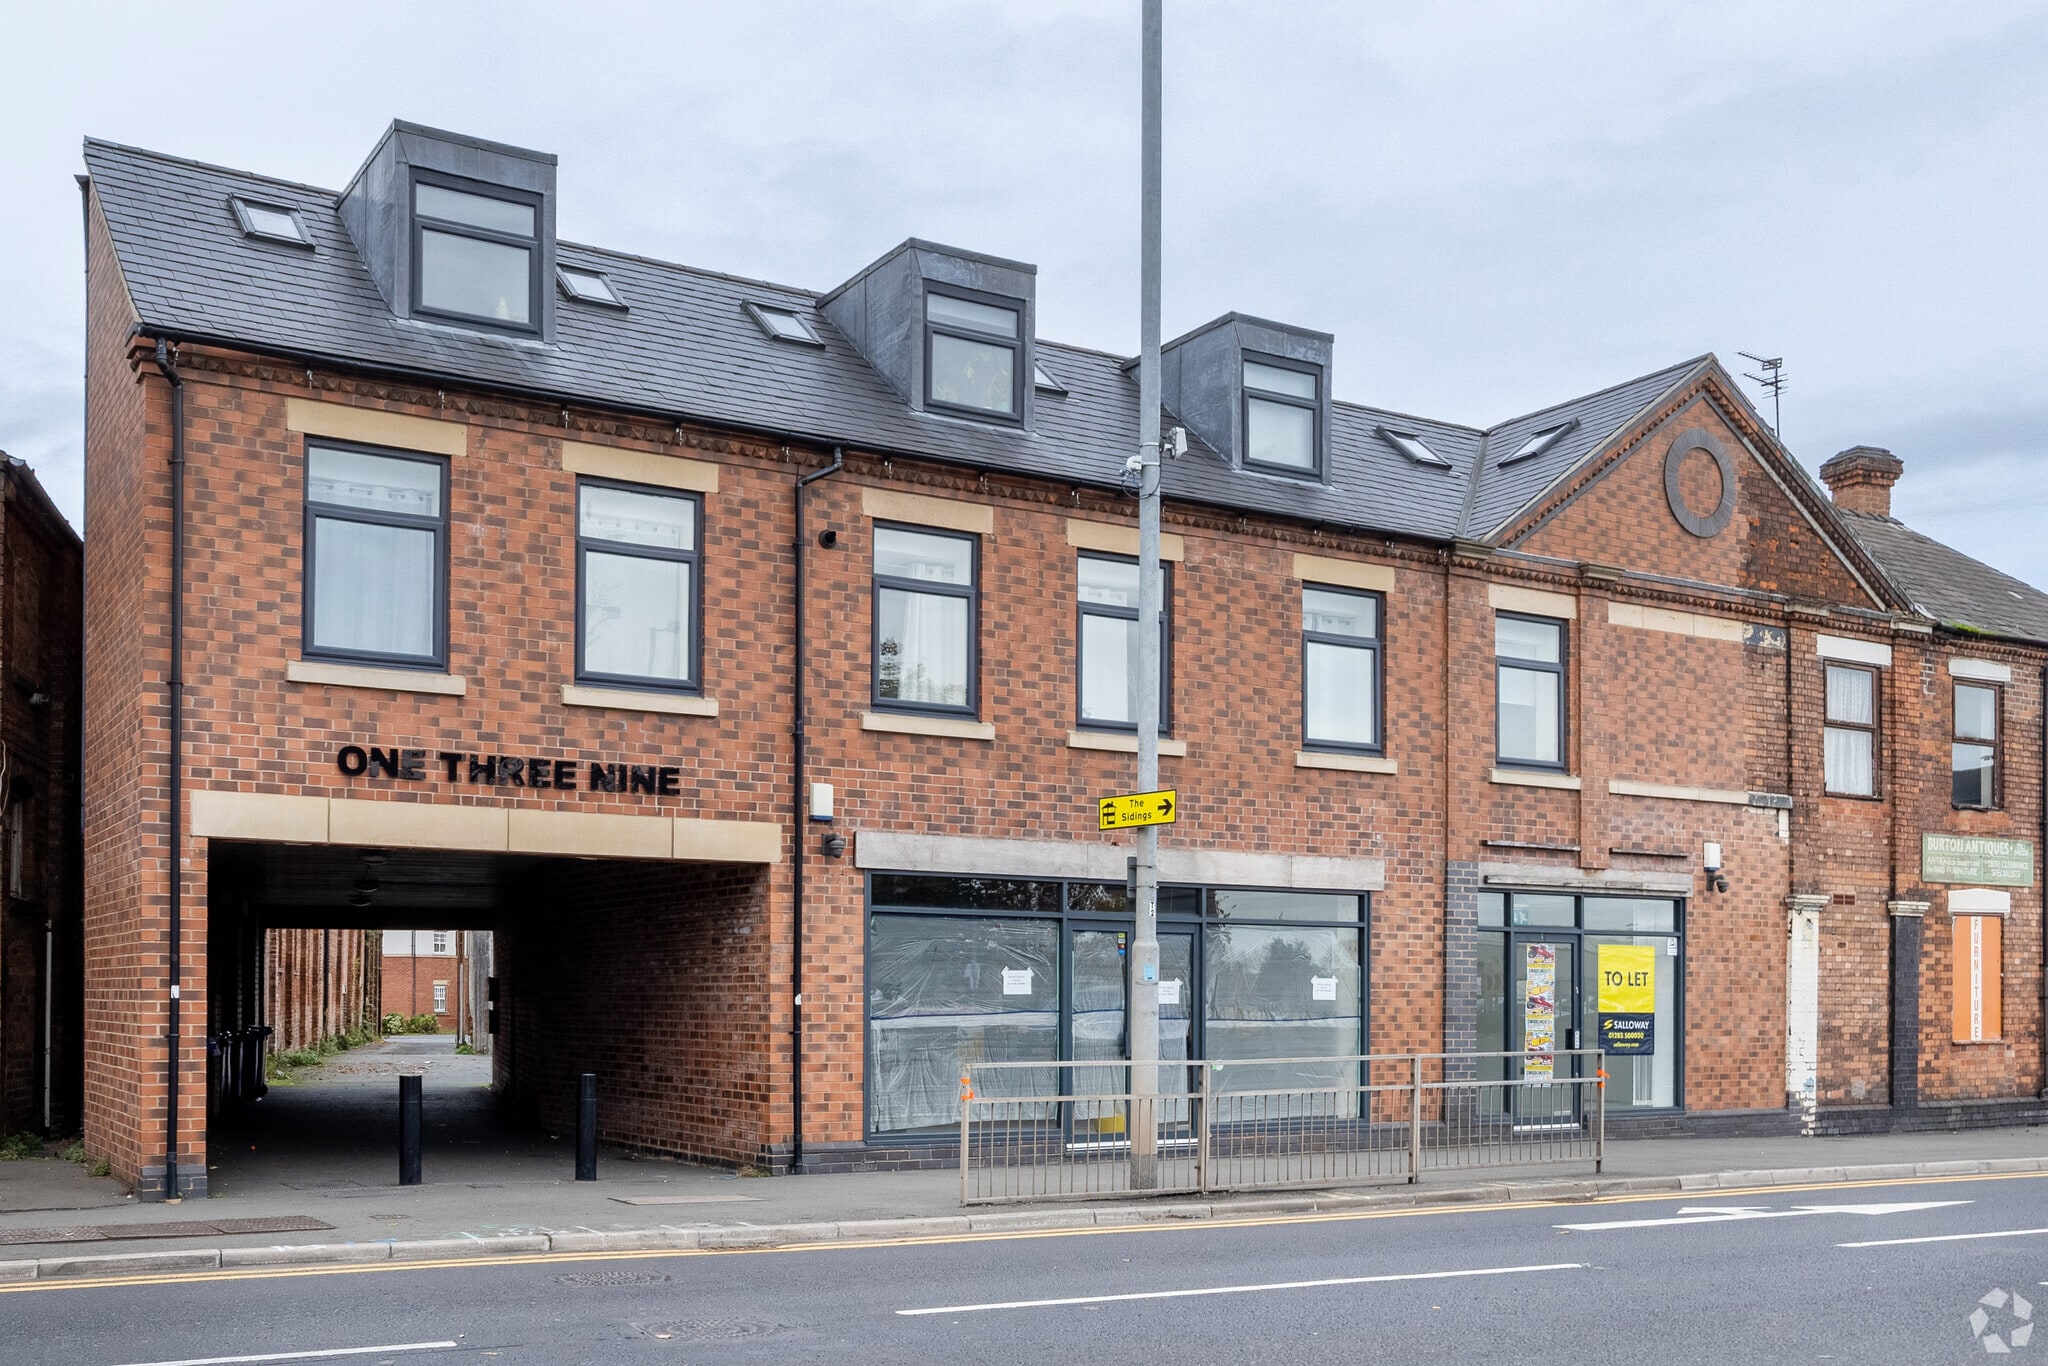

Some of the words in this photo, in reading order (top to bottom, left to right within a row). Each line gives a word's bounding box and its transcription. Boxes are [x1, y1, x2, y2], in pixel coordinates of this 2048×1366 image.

[337, 746, 426, 781] ONE
[440, 752, 577, 790] THREE
[591, 762, 681, 796] NINE
[1129, 799, 1144, 808] The
[1121, 812, 1152, 822] Sidings
[1927, 837, 1964, 853] BURTON
[1965, 840, 2010, 857] ANTIQUES
[1605, 971, 1623, 986] TO
[1628, 971, 1649, 986] LET
[1613, 1020, 1650, 1030] SALLOWAY
